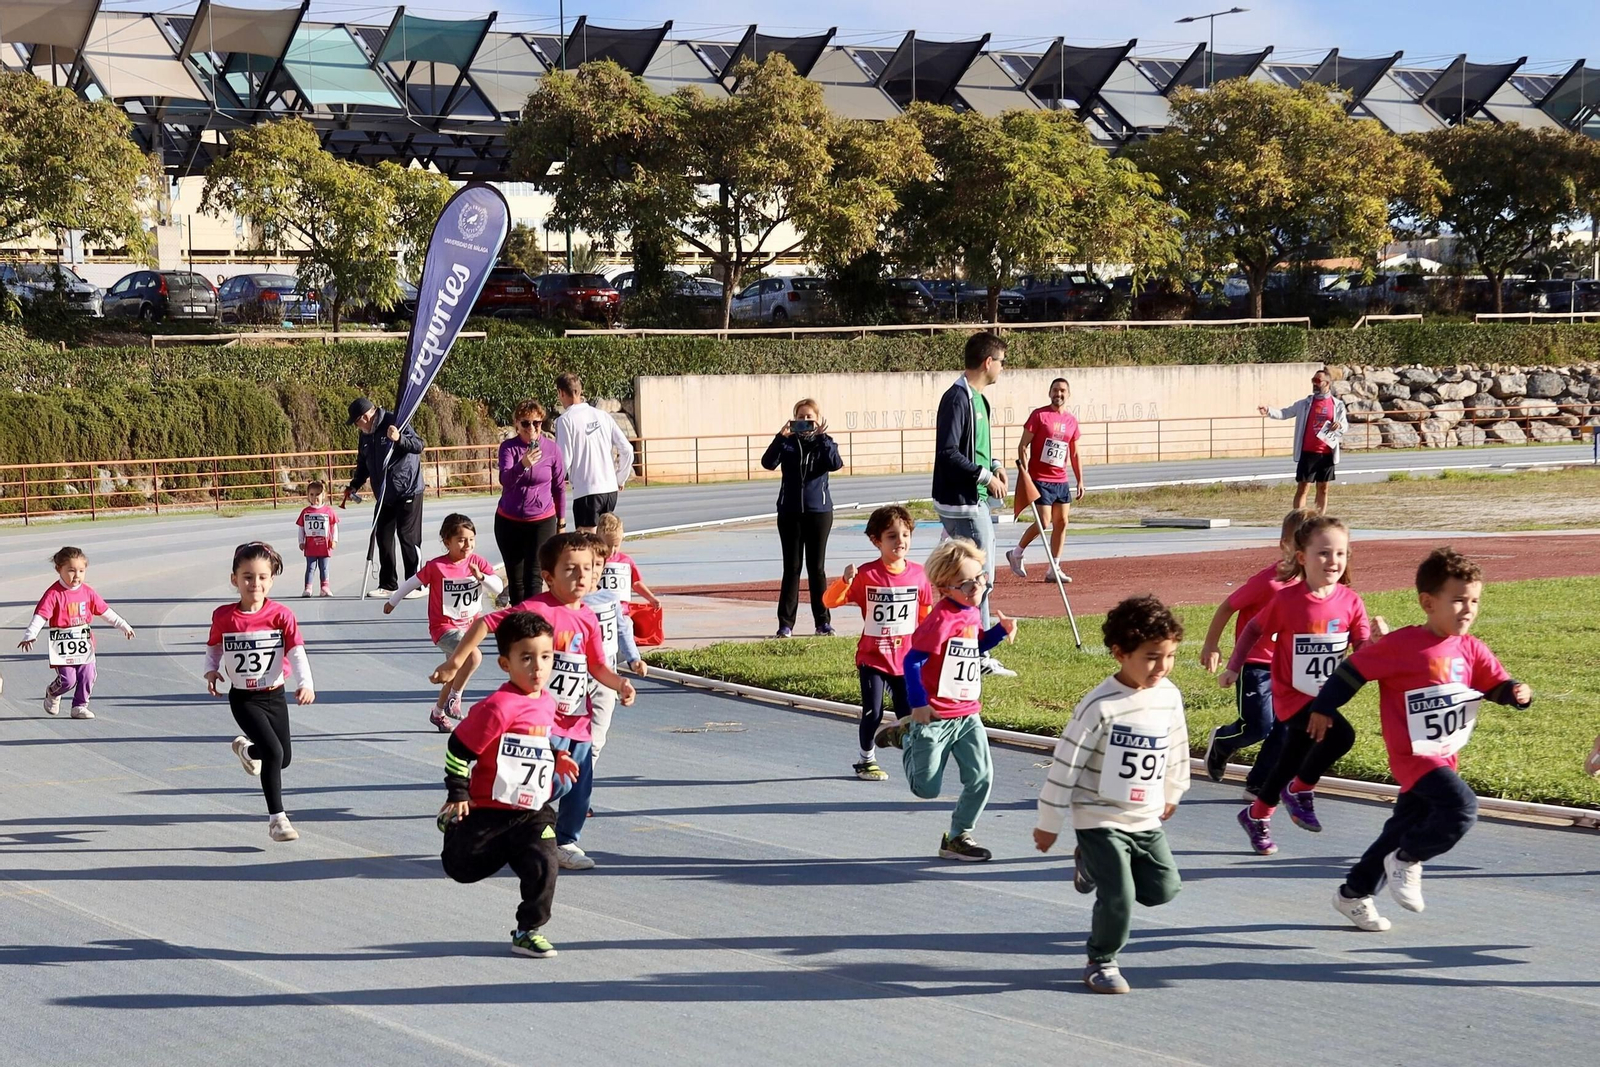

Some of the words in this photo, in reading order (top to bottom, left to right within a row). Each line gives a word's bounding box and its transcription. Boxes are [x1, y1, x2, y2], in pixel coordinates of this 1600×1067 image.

[444, 238, 468, 249] UNIVERSIDAD
[586, 421, 599, 430] NIKE
[1053, 421, 1066, 433] WE
[309, 520, 325, 530] 101
[451, 588, 479, 608] 704
[868, 594, 891, 602] UMA
[68, 601, 86, 616] WE
[873, 603, 909, 622] 614
[57, 640, 88, 656] 198
[226, 641, 252, 651] UMA
[949, 646, 975, 657] UMA
[1297, 644, 1330, 653] UMA
[234, 651, 276, 674] 237
[555, 660, 575, 672] MA
[549, 673, 585, 698] 473
[1410, 698, 1449, 712] UMA
[1424, 705, 1467, 741] 501
[1113, 733, 1152, 749] UMA
[503, 744, 538, 759] UMA
[519, 795, 533, 805] WE
